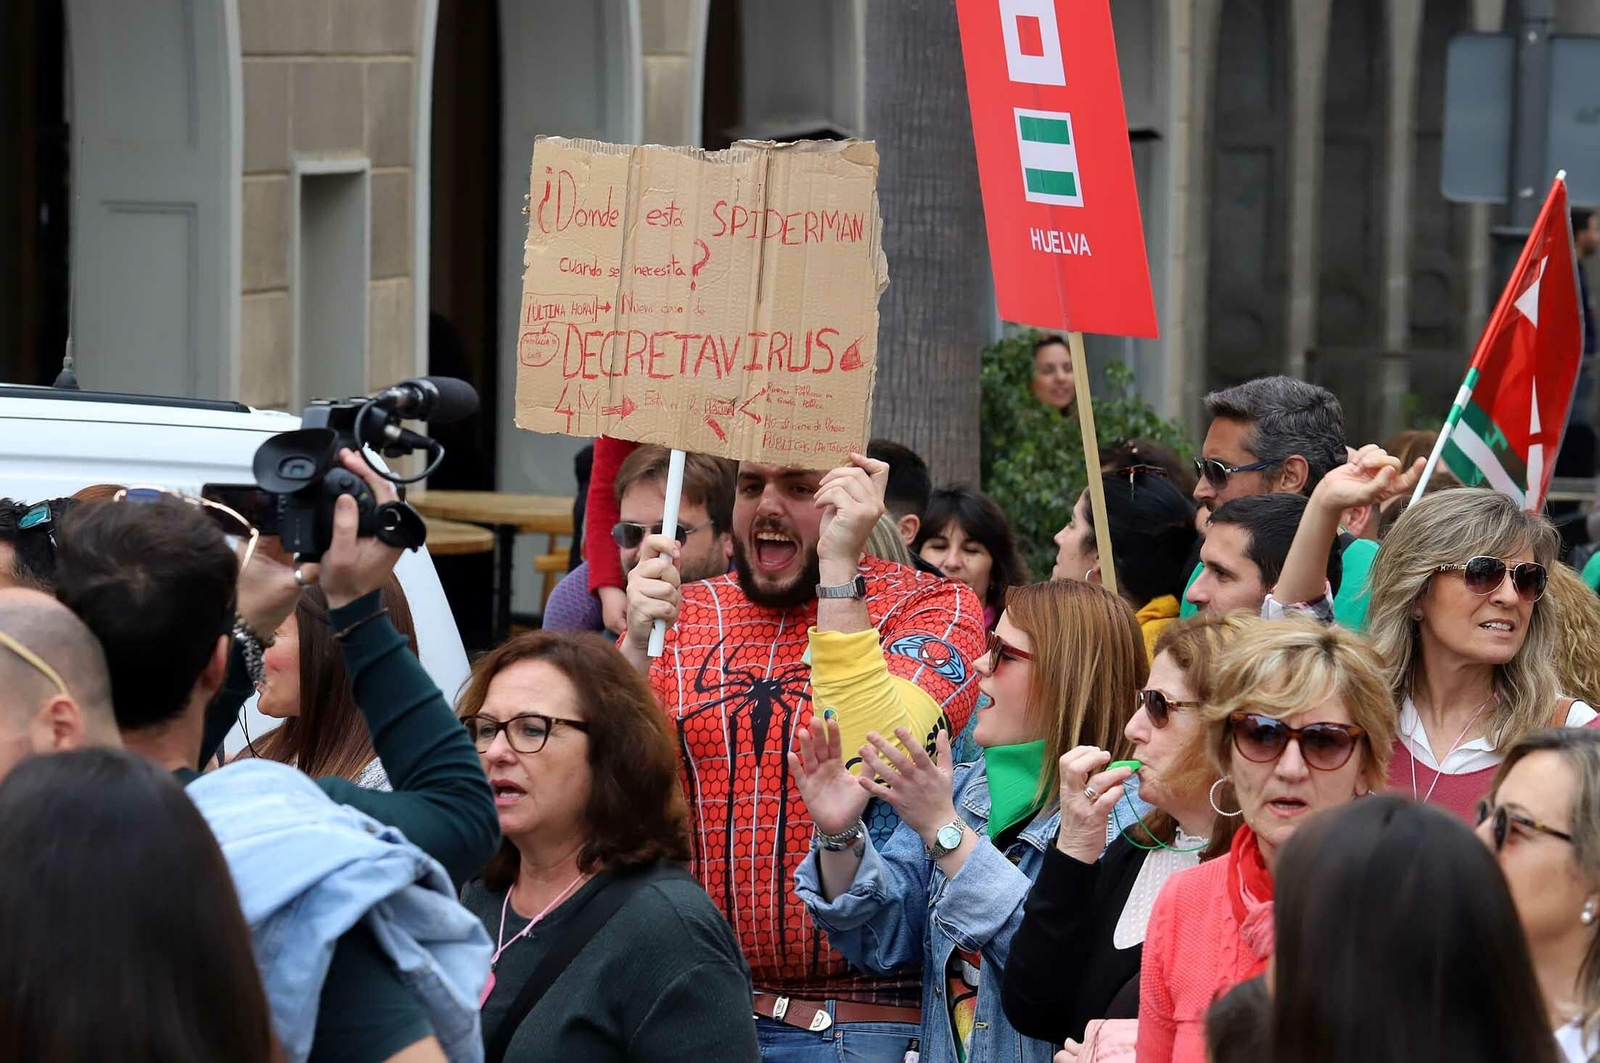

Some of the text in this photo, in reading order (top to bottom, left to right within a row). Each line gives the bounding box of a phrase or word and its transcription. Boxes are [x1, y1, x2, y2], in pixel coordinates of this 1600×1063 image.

[712, 200, 865, 246] SPIDERMAN
[1029, 227, 1092, 256] HUELVA
[609, 267, 620, 277] se
[661, 304, 683, 315] caso
[562, 323, 840, 381] DECRETAVIRUS
[554, 382, 600, 434] 4M
